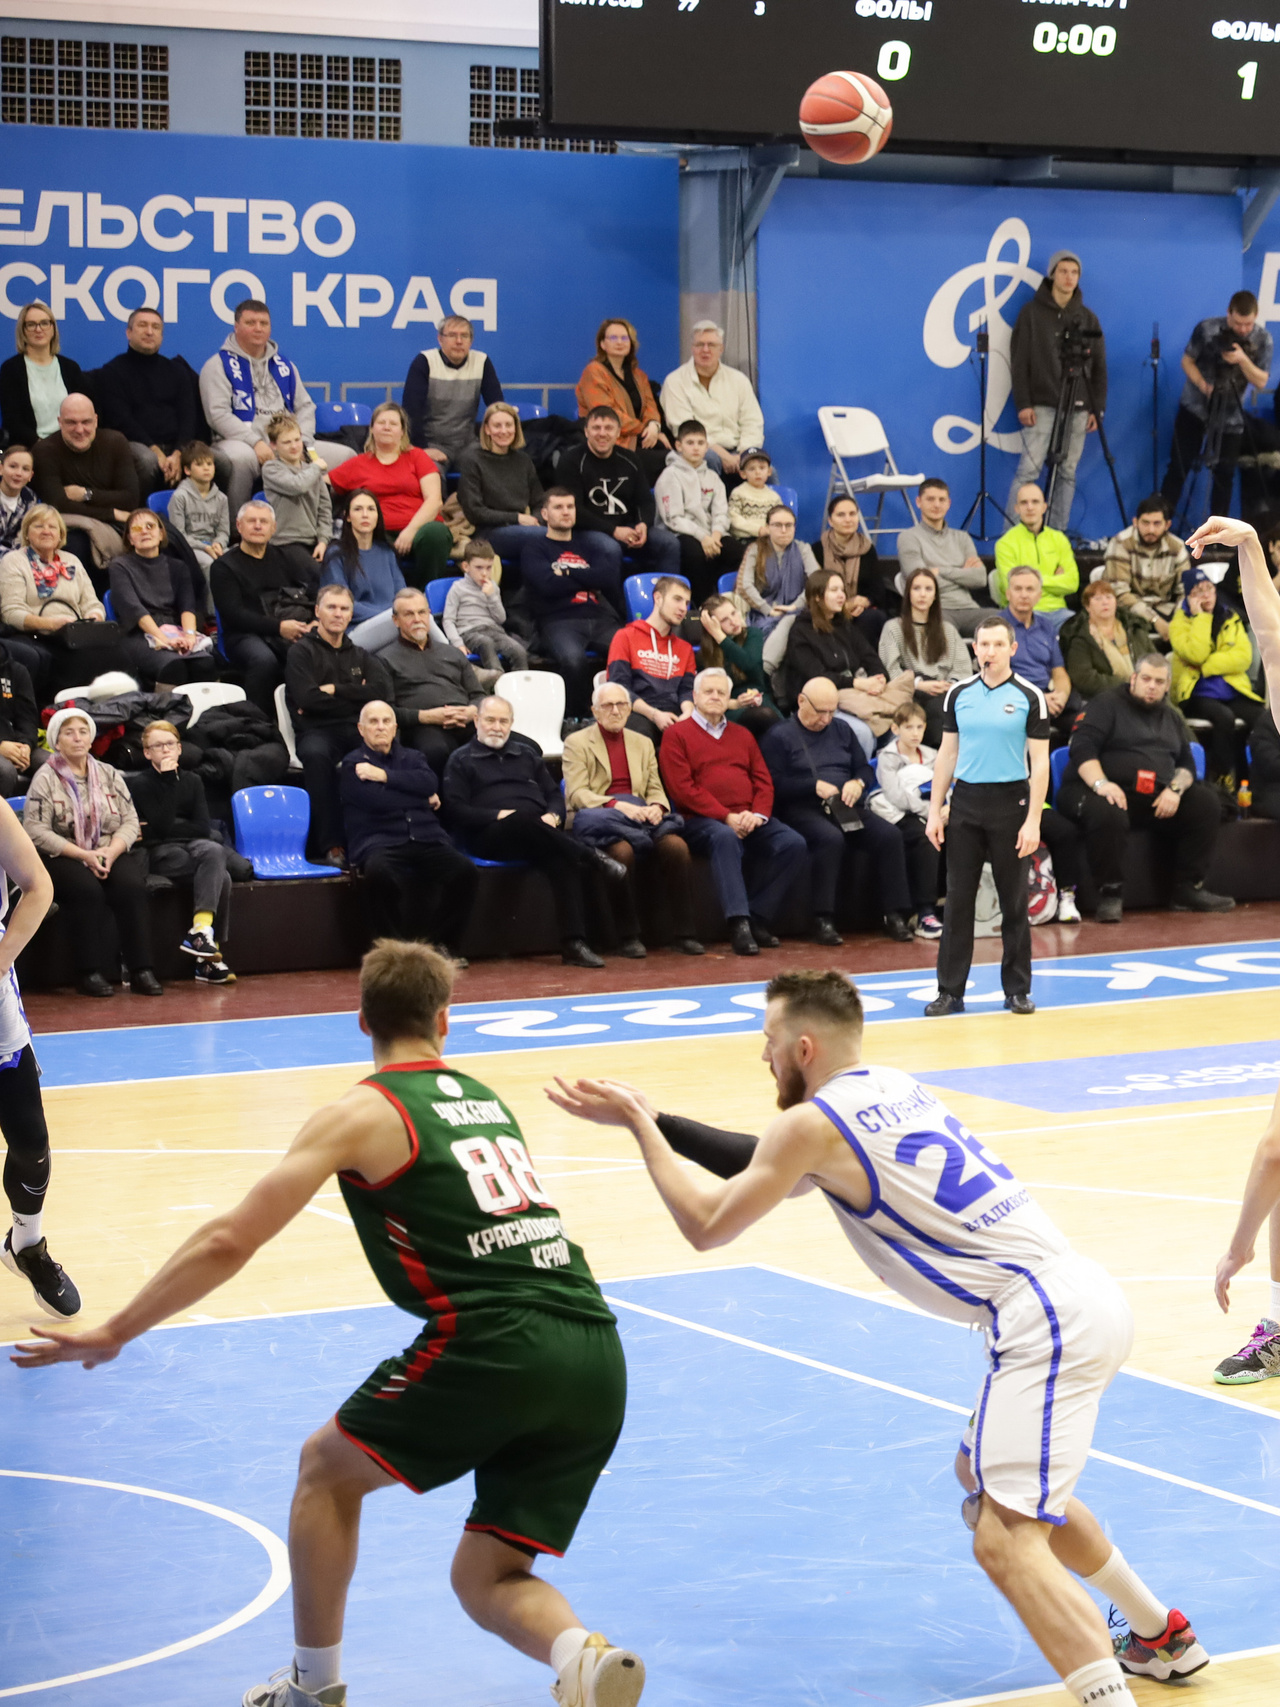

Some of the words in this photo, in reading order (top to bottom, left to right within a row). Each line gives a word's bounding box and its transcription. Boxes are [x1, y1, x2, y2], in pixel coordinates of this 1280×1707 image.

[855, 0, 932, 21] ФОЛЫ
[1032, 22, 1117, 57] 0:00
[877, 40, 911, 81] 0
[1236, 61, 1259, 100] 1
[0, 261, 266, 324] СКОГО
[292, 271, 498, 332] КРАЯ
[450, 1135, 554, 1217] 88
[530, 1238, 571, 1269] КРАЙ
